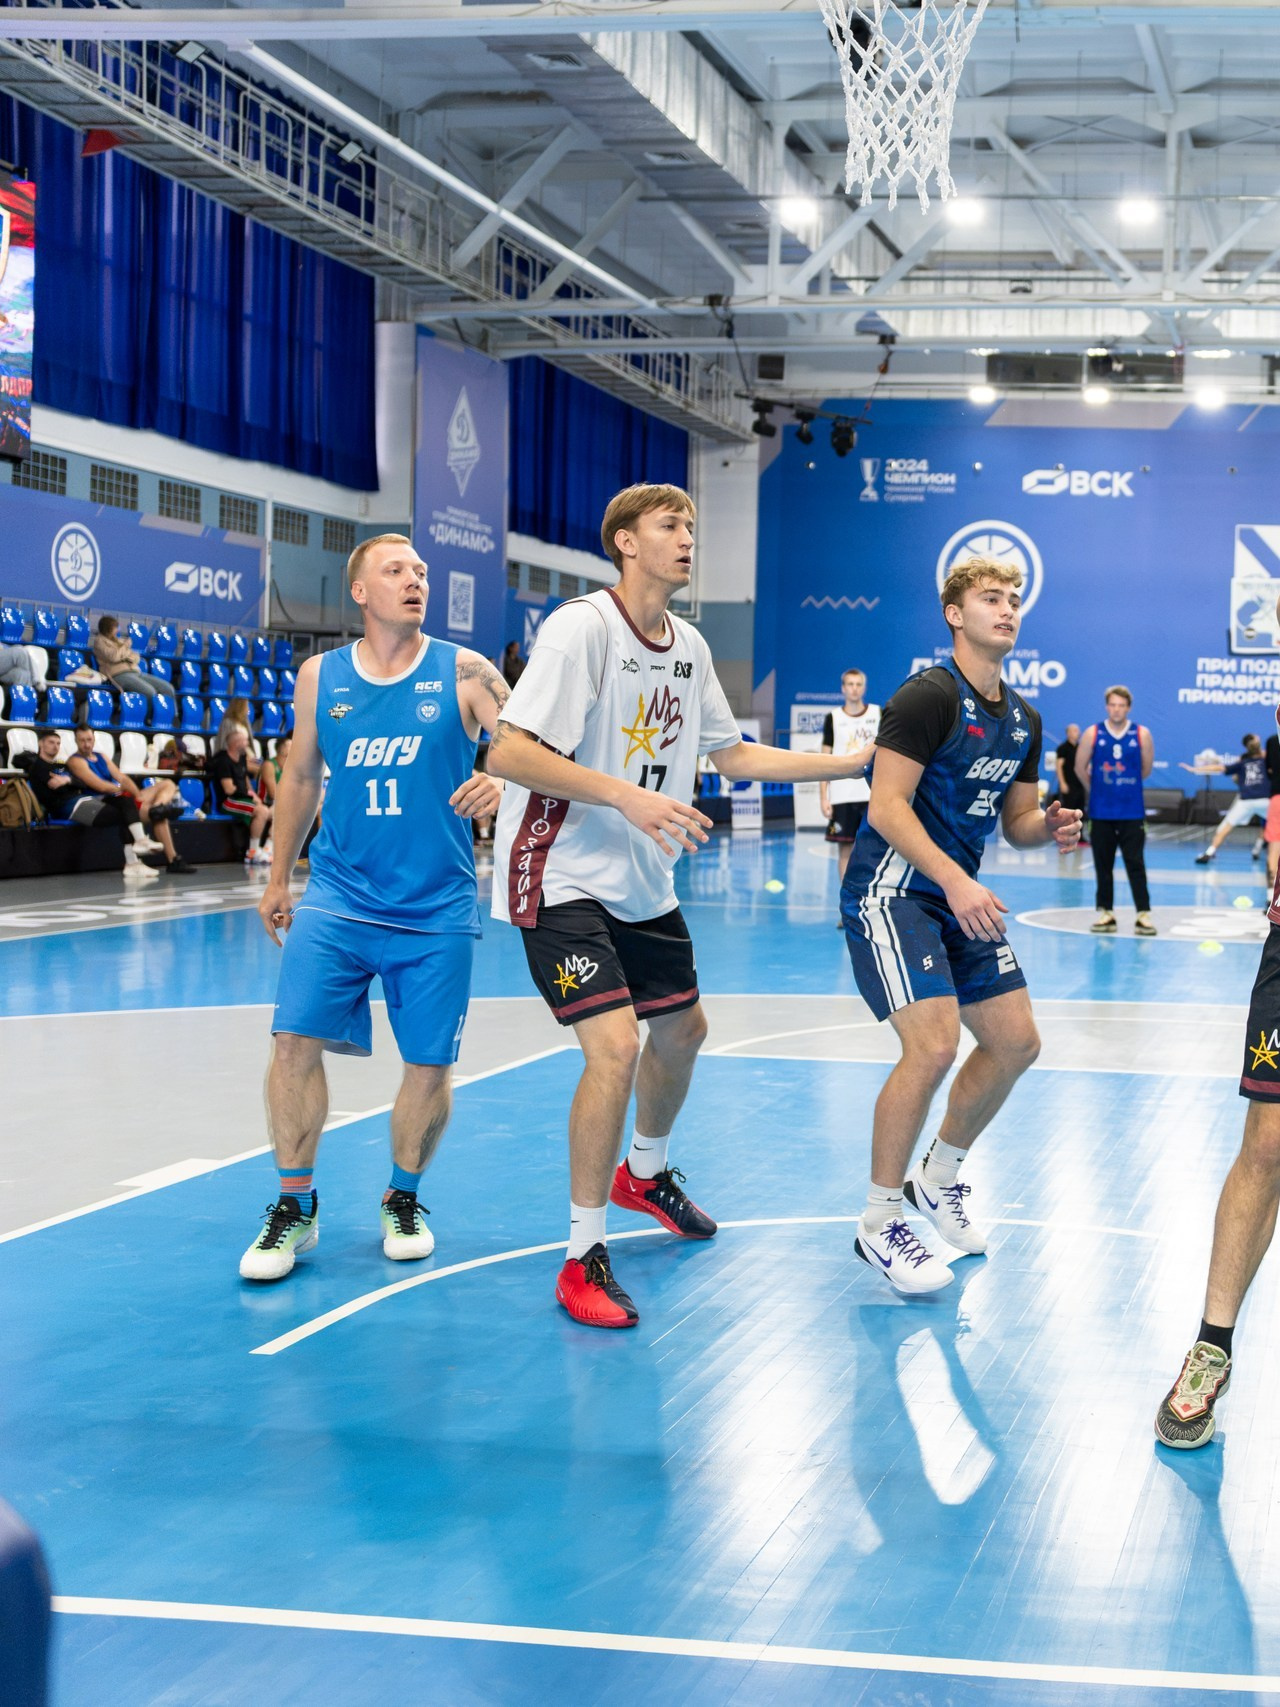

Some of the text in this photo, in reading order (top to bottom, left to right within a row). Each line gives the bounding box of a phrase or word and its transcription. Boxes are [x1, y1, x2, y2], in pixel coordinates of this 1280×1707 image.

[1196, 657, 1238, 673] ПРИ
[1178, 688, 1280, 706] ПРИМОРСК
[365, 778, 402, 816] 11
[996, 944, 1021, 975] 2
